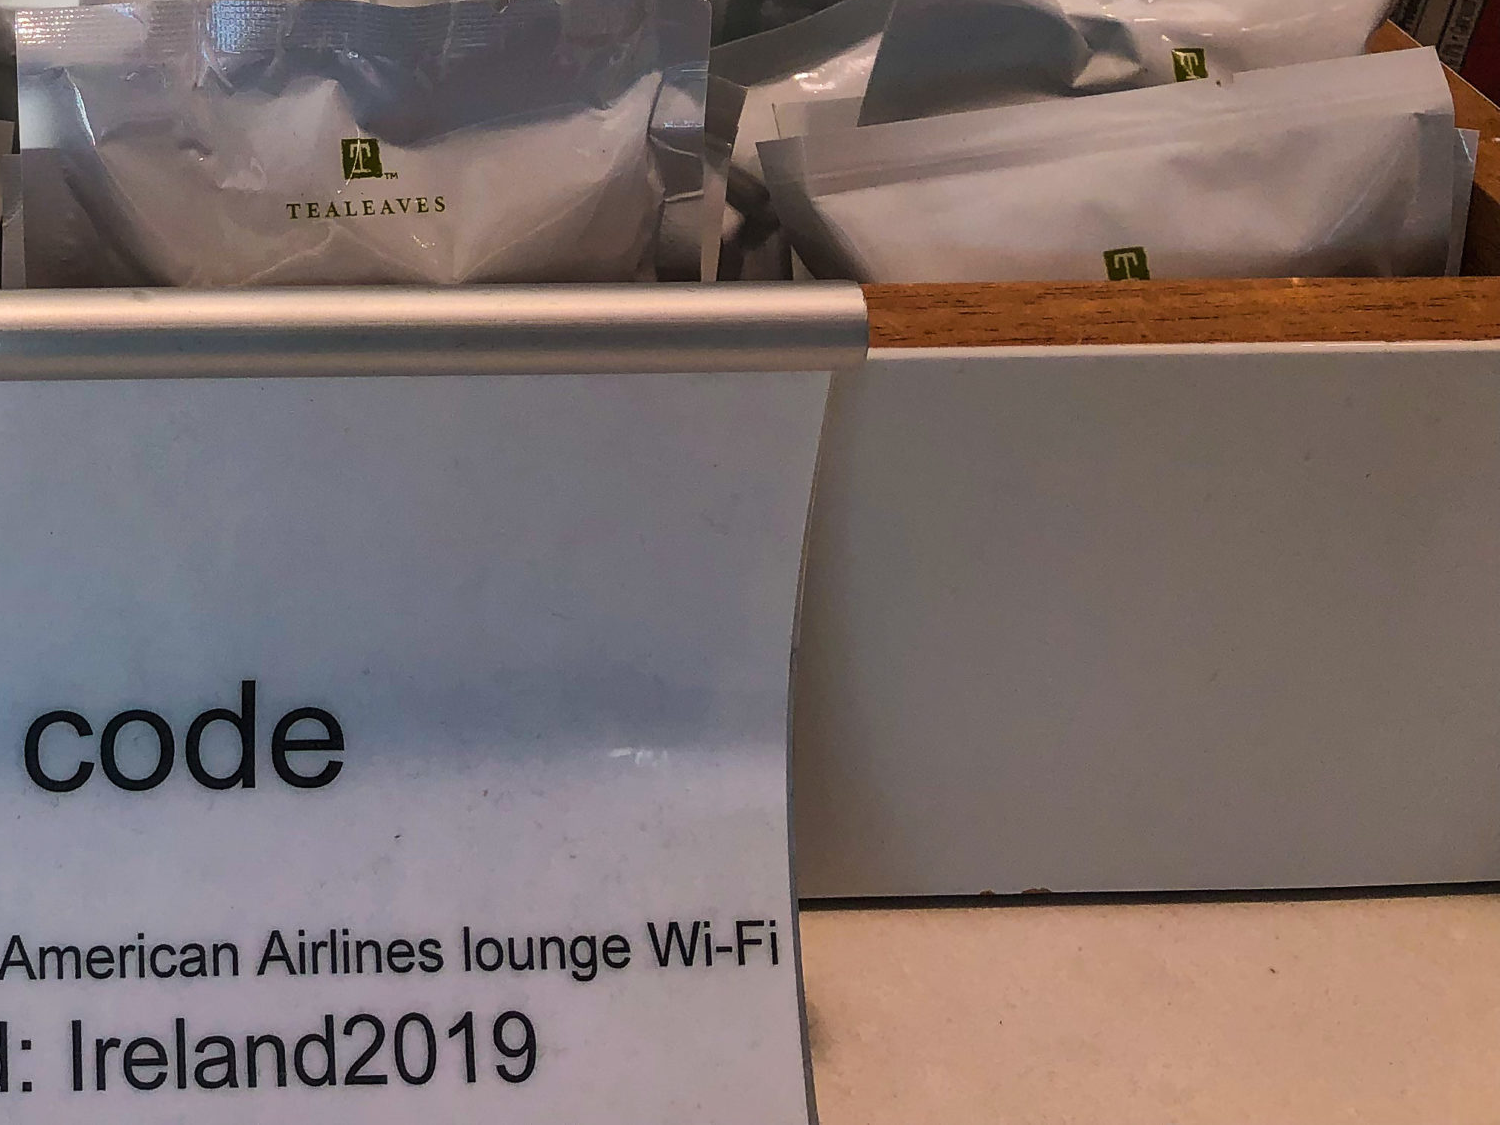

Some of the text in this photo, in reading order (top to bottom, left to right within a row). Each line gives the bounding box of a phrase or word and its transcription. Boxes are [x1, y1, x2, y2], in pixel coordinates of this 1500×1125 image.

[286, 196, 446, 219] TEALEAVES
[23, 680, 346, 795] code
[258, 928, 445, 976] Airlines
[463, 926, 632, 982] lounge
[646, 919, 780, 968] Wi-Fi
[72, 1009, 539, 1092] Ireland2019
